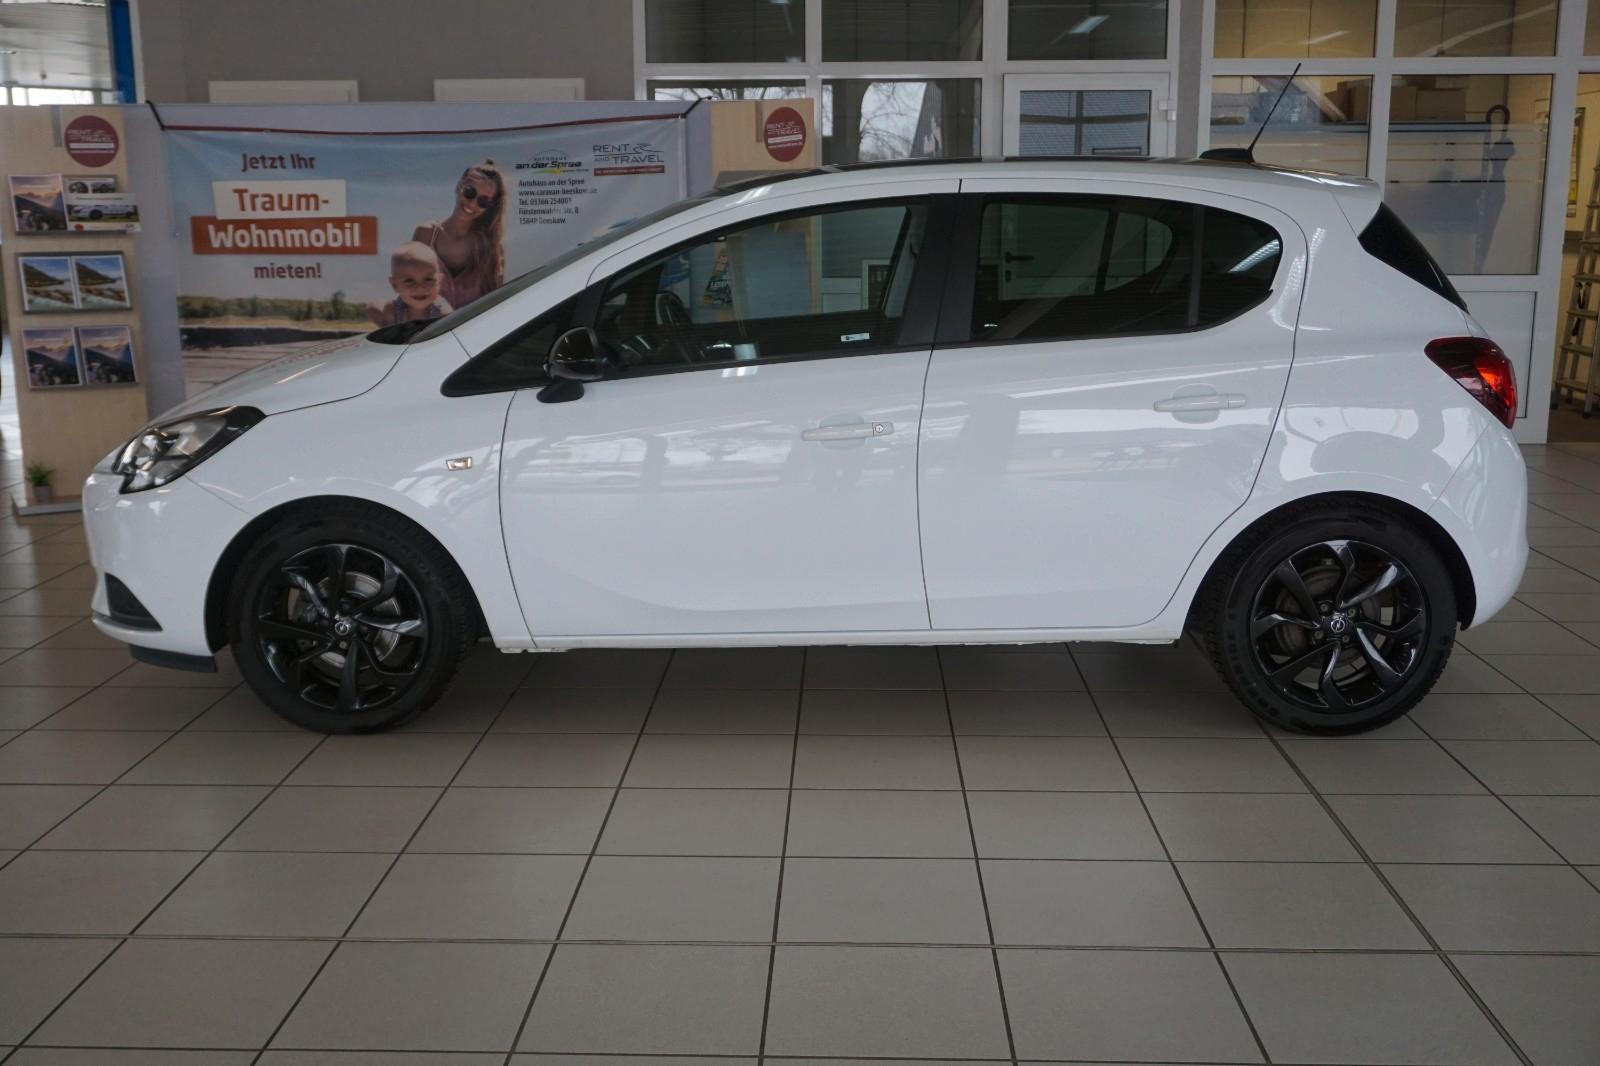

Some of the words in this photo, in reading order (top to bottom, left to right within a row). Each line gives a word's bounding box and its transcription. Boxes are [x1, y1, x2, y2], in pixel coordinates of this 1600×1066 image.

[592, 144, 630, 153] RENT
[242, 154, 286, 172] Jetzt
[291, 154, 316, 169] Ihr
[612, 154, 665, 165] TRAVEL
[232, 188, 329, 212] Traum-
[208, 222, 361, 249] Wohnmobil
[254, 262, 322, 279] mieten!
